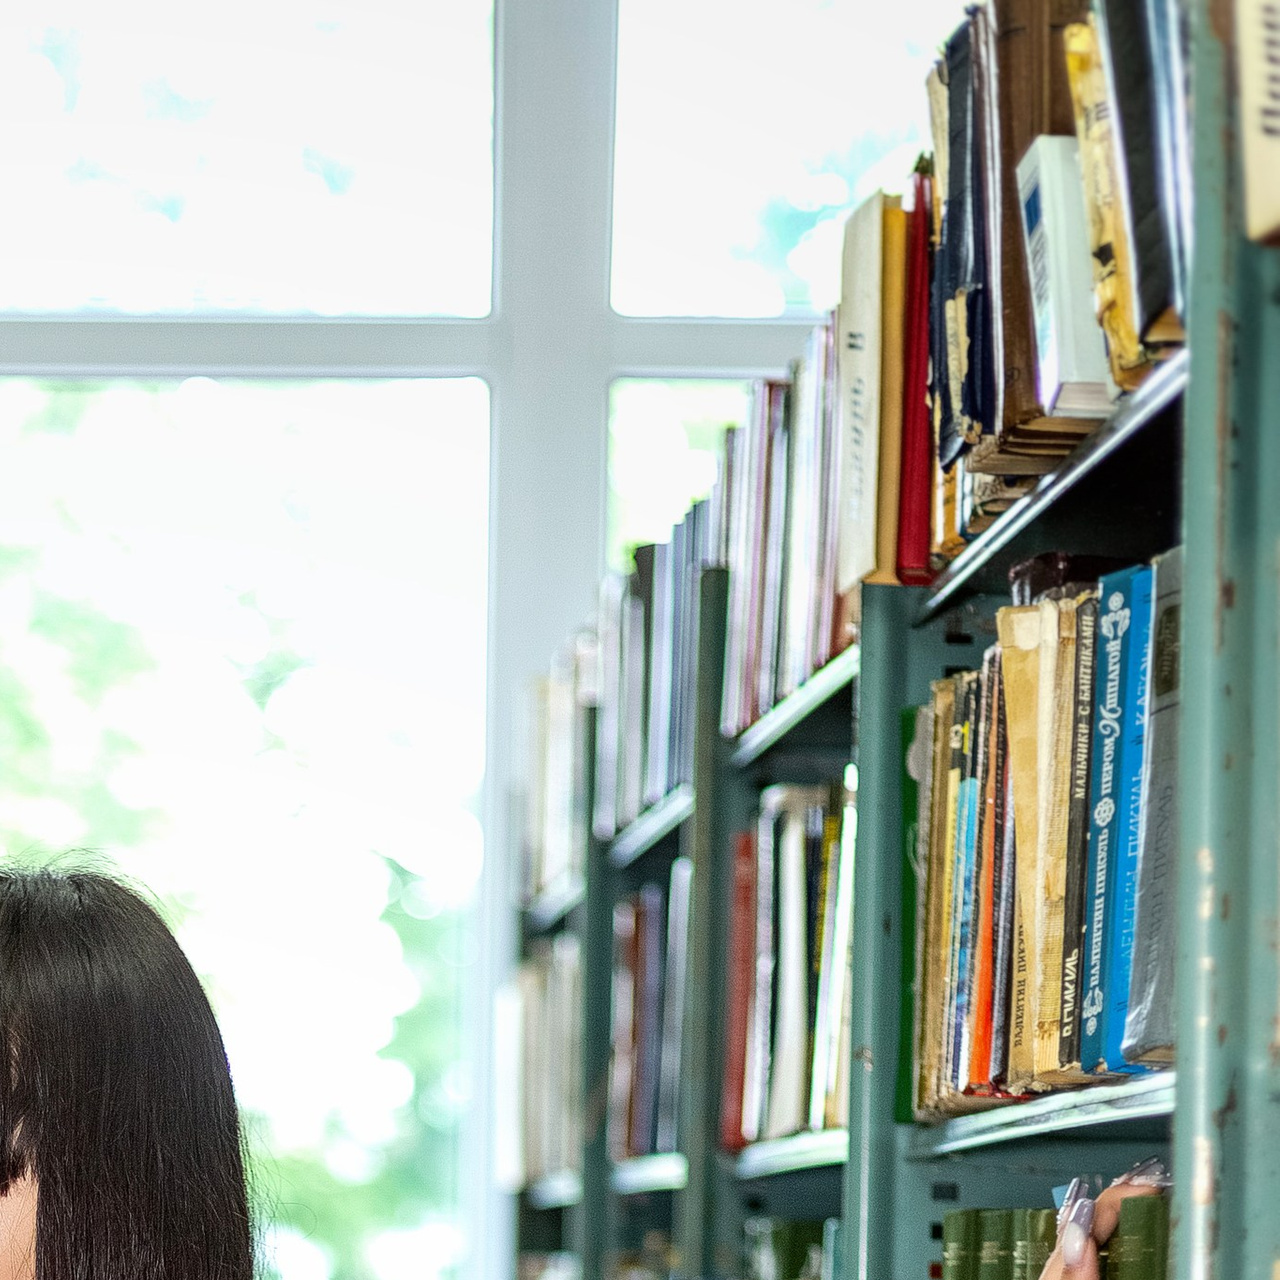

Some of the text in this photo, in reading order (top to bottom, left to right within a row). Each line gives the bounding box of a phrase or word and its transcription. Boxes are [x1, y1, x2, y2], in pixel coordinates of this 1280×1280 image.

[1074, 614, 1094, 799] МАЛЬЧИКИ С БАНТИКАМИ
[1105, 637, 1122, 709] ШПАГОЙ
[1101, 736, 1116, 795] ПЕРОМ
[1094, 829, 1109, 896] ПИКУЛЬ
[1089, 896, 1104, 988] ВАЛЕНТИН
[1014, 978, 1026, 1048] ВАЛЕНТИН
